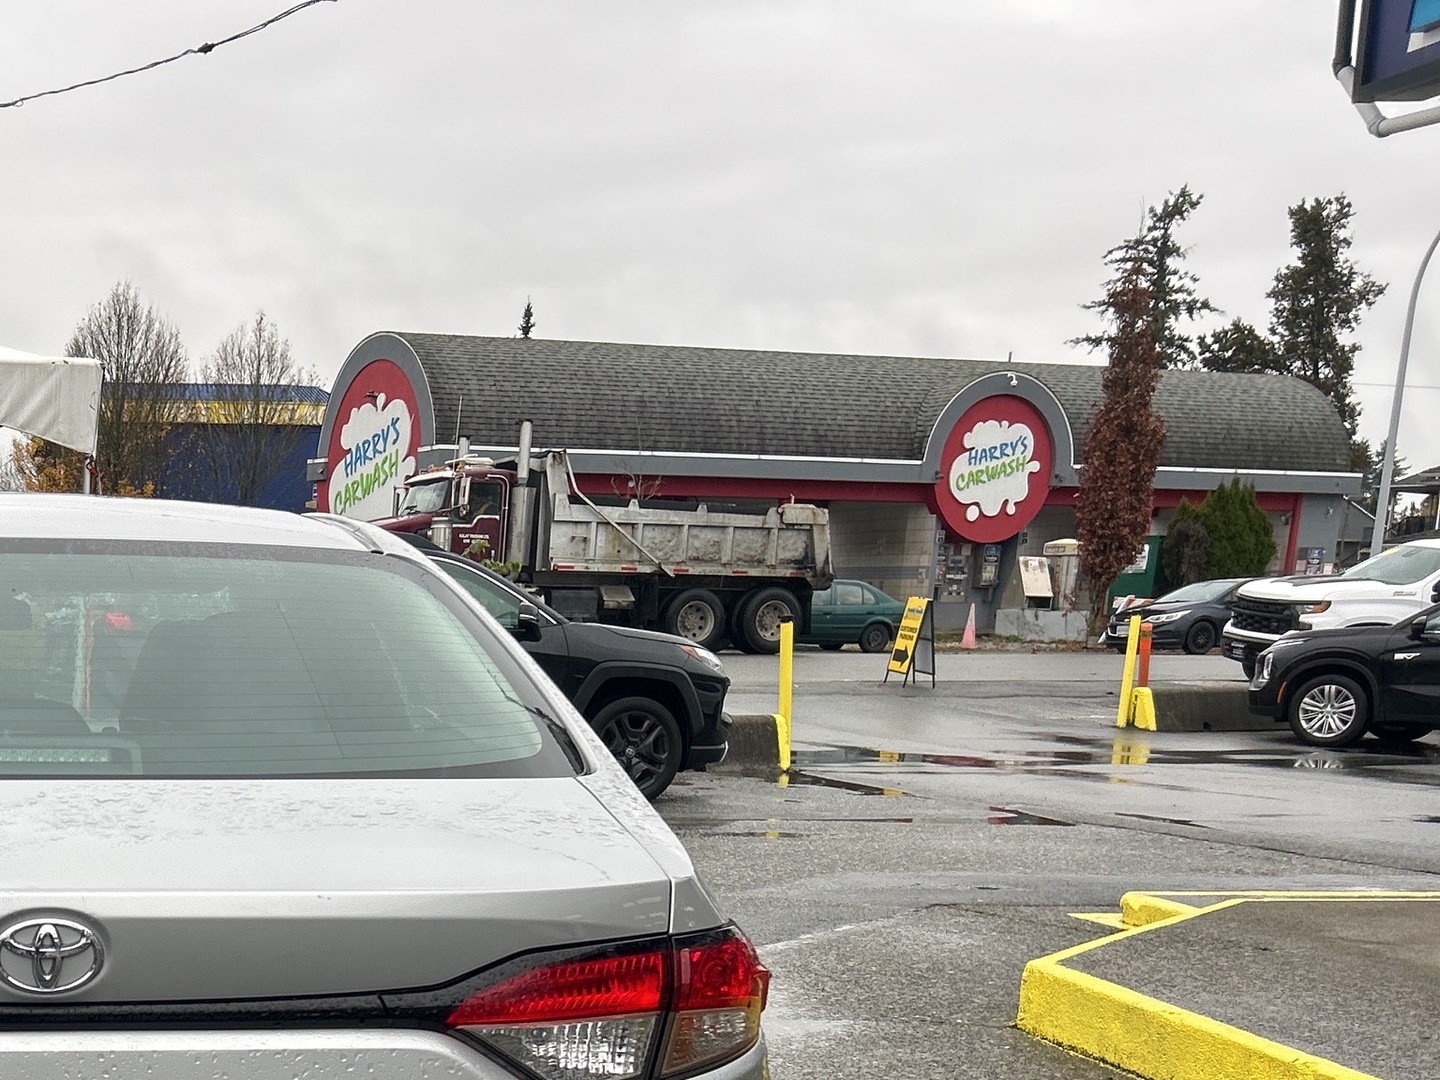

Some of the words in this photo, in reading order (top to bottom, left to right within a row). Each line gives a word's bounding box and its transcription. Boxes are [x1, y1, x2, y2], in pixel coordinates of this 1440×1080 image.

[344, 417, 401, 477] HARRY'S
[968, 435, 1028, 466] HARRY'S
[333, 449, 399, 515] CARWASH
[956, 455, 1027, 491] CARWASH
